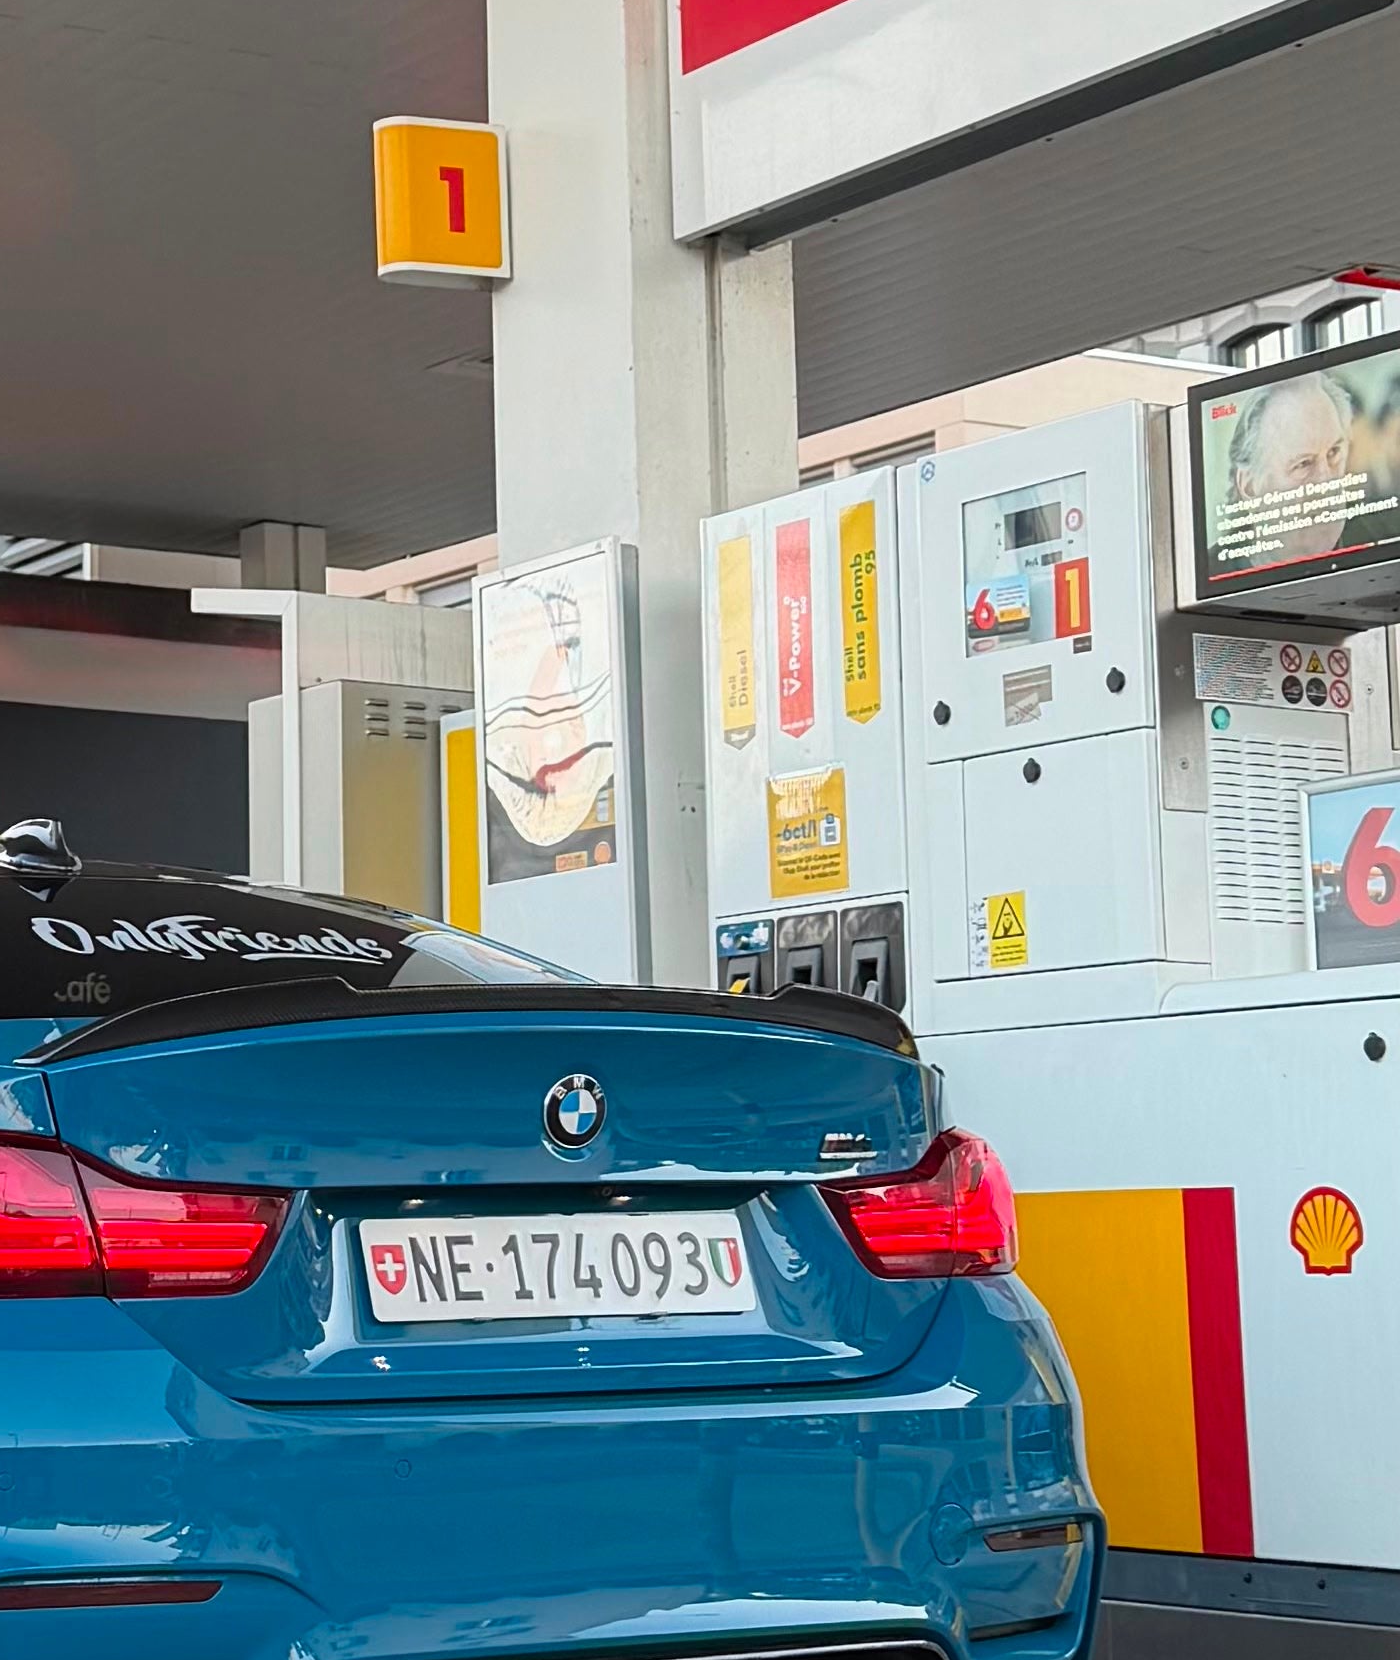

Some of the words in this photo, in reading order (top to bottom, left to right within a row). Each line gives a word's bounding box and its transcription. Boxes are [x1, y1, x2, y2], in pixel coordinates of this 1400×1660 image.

[439, 166, 465, 233] 1
[1216, 498, 1262, 516] L'acteur
[1263, 485, 1304, 505] Gérard
[1305, 473, 1367, 495] Depardieu
[1217, 509, 1280, 531] abandonne
[1282, 503, 1301, 516] ses
[1303, 489, 1365, 514] poursuites
[1218, 530, 1254, 546] contre
[1255, 516, 1312, 538] l'émission
[864, 549, 876, 575] 95
[849, 553, 868, 623] plomb
[1065, 568, 1080, 629] 1
[788, 599, 802, 696] V-Power
[844, 646, 854, 682] Shell
[855, 630, 867, 680] sans
[737, 649, 749, 707] Diesel
[32, 915, 393, 965] OnlyFriends
[553, 1076, 605, 1100] BMW
